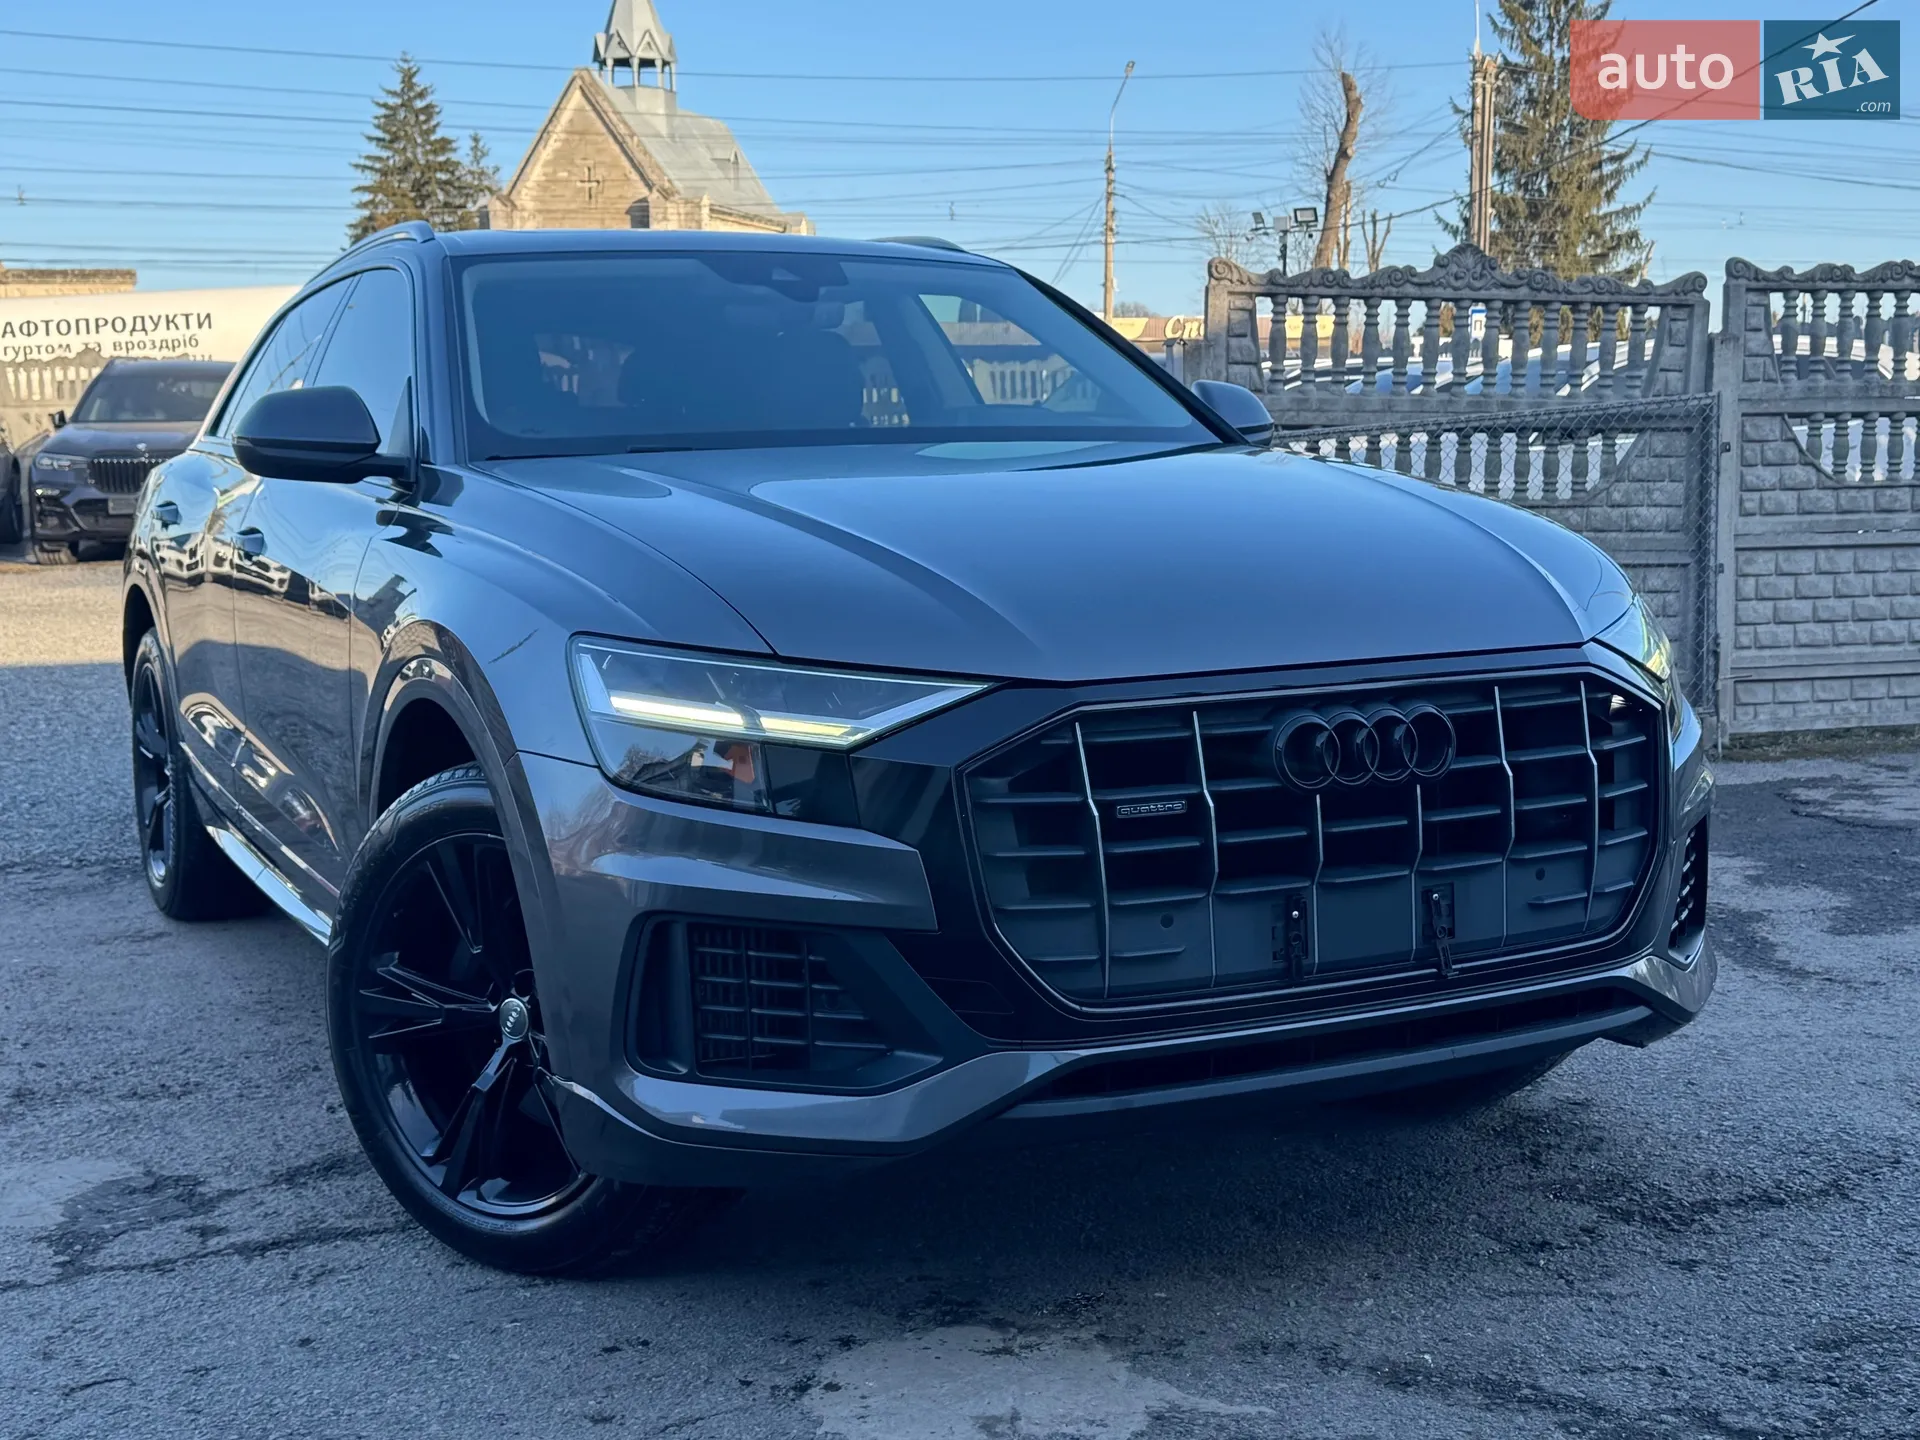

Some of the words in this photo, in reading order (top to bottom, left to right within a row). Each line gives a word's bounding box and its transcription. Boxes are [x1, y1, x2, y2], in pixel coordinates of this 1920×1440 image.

[1, 313, 213, 338] АФТОПРОДУКТИ
[112, 333, 199, 355] вроздріб
[1120, 803, 1182, 814] quattro
